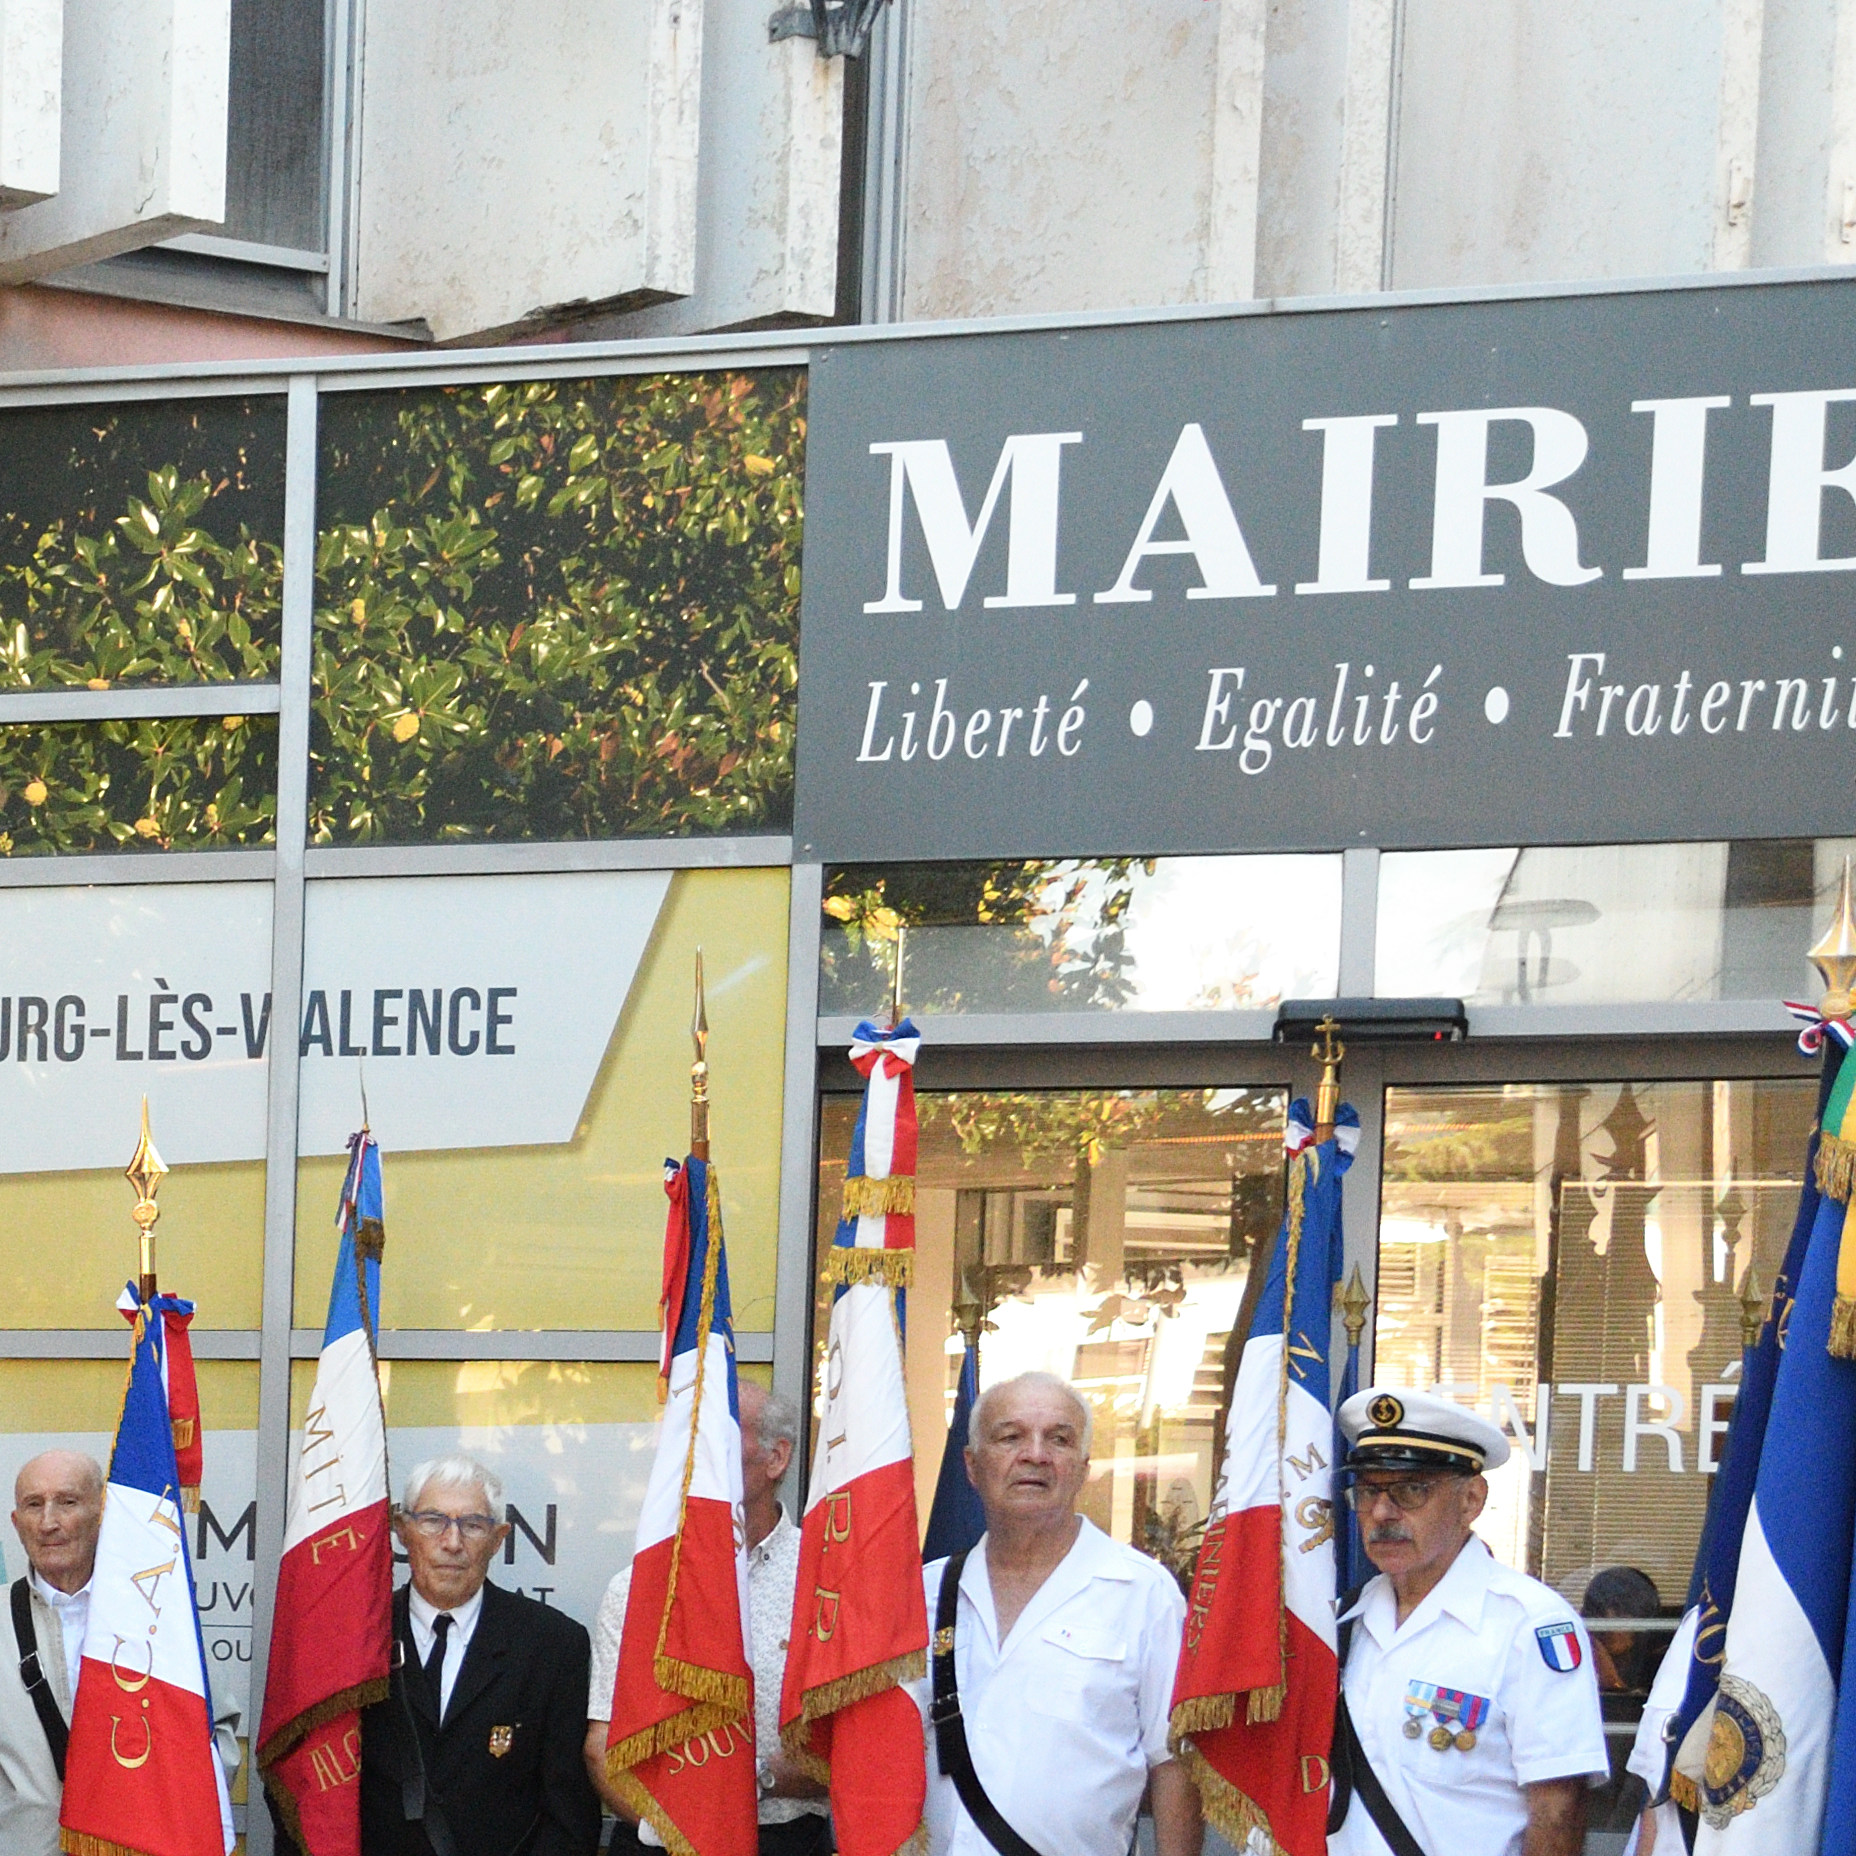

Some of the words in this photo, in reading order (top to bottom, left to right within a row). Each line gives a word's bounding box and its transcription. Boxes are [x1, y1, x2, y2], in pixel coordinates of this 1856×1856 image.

[856, 677, 1090, 764] Liberté
[1195, 663, 1445, 776] Egalité
[1552, 645, 1856, 740] Fraterni
